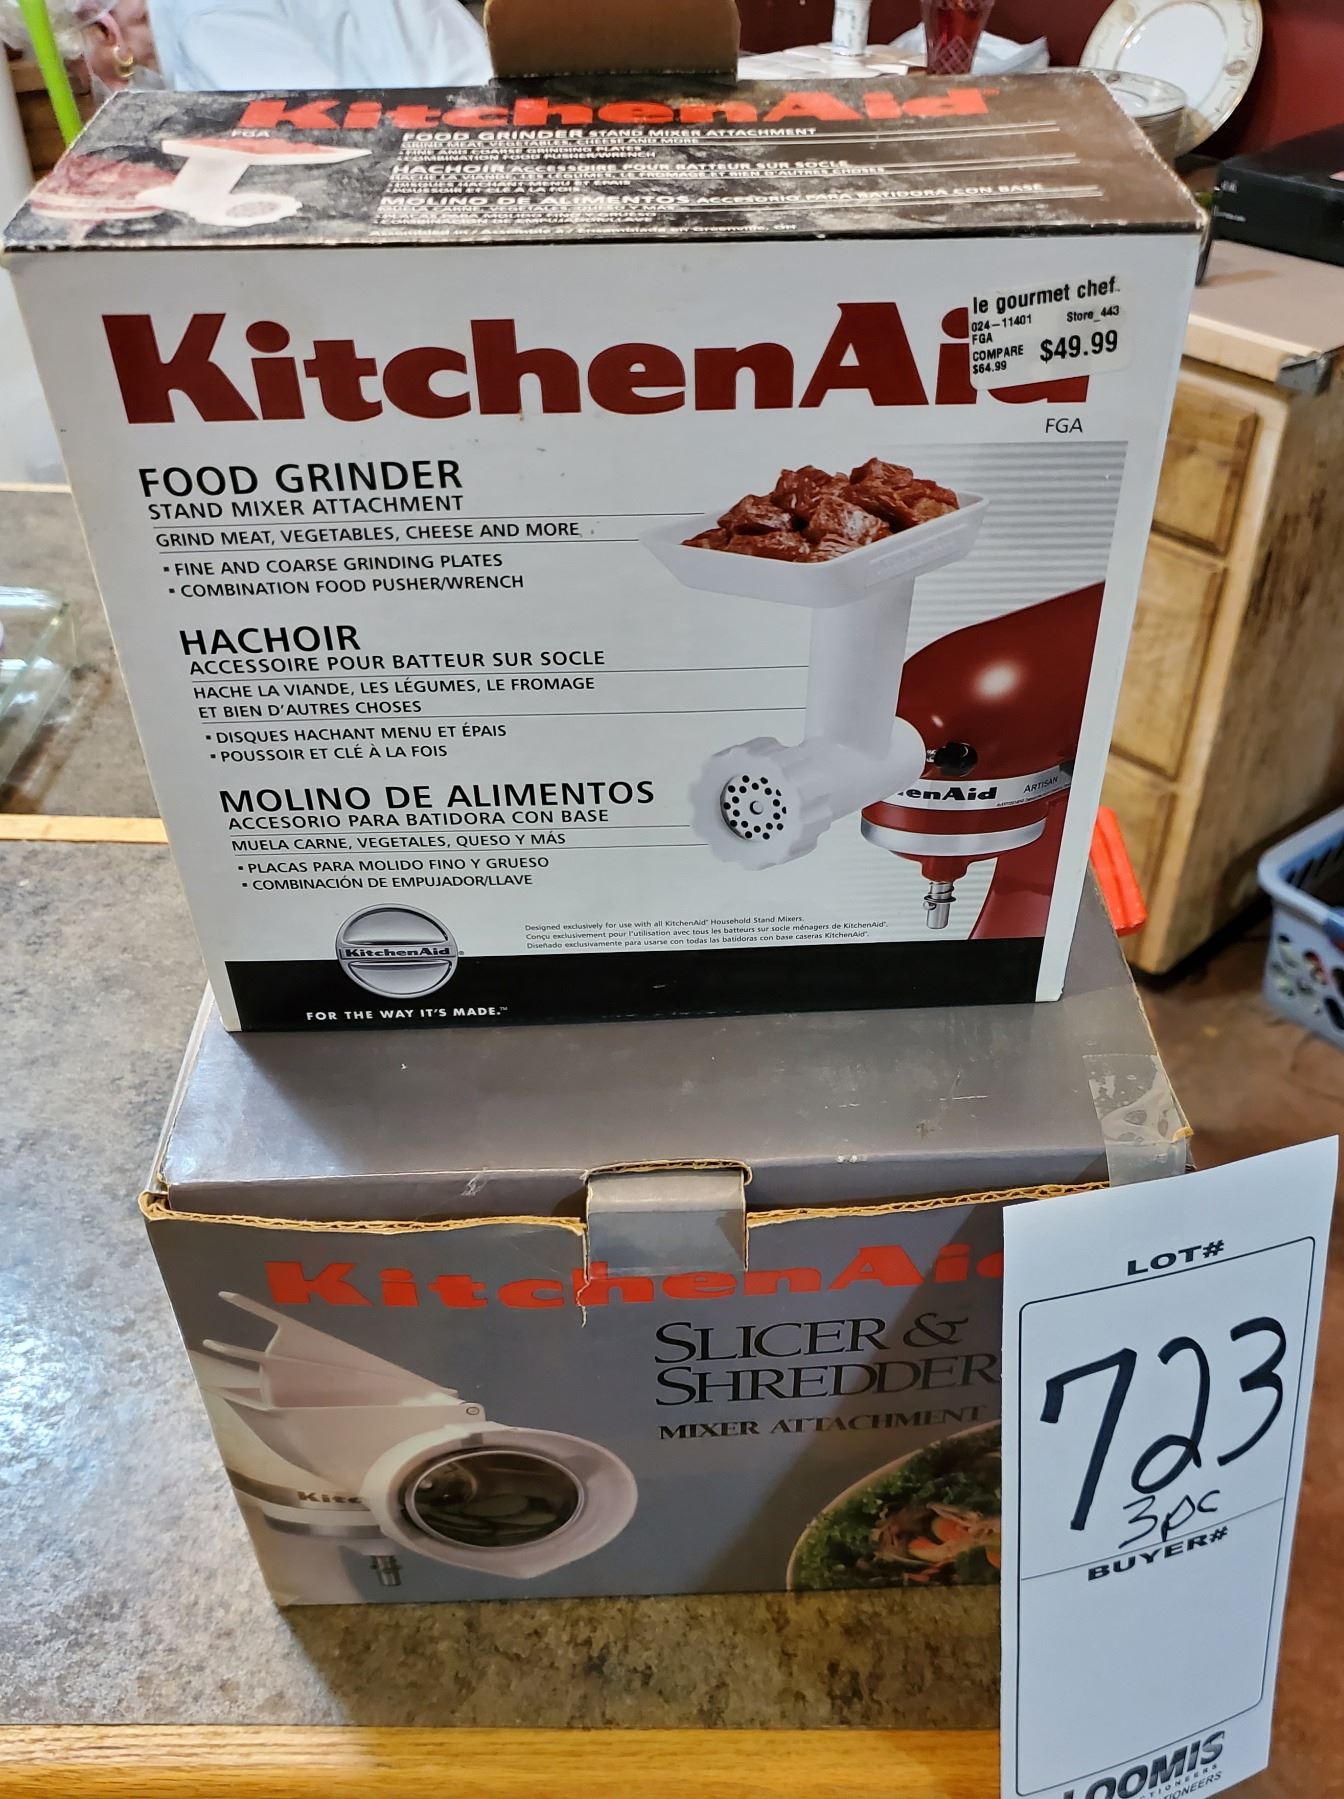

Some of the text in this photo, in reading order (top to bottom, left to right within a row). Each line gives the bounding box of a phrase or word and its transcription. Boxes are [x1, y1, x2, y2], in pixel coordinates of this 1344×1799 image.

[236, 88, 988, 129] KitchenAid
[402, 131, 470, 142] FOOD
[478, 129, 583, 140] GRINDER
[649, 128, 700, 137] MIXER
[706, 128, 816, 136] ATTACHMENT
[973, 296, 988, 314] le
[996, 284, 1070, 313] gourmet
[972, 333, 993, 345] FGA
[1040, 329, 1118, 364] $49.99
[101, 303, 1089, 424] KitchenAi
[972, 344, 1024, 362] COMPARE
[972, 361, 1007, 375] $64.99
[1045, 418, 1083, 433] FGA
[139, 459, 463, 498] FOOD GRINDER
[148, 495, 464, 521] STAND MIXER ATTACHMENT
[156, 521, 579, 548] GRIND MEAT, VEGETABLES, CHEESE AND MORE
[175, 553, 503, 576] FINE AND COARSE GRINDING PLATES
[180, 574, 524, 598] COMBINATION FOOD PUSHER/WRENCH
[179, 624, 361, 656] HACHOIR
[190, 650, 605, 675] ACCESSOIRE POUR BATTEUR SUR SOCLE
[193, 676, 595, 700] HACHE LA VIANDE, LES LÉGUMES, LE FROMAGE
[198, 706, 219, 719] ET
[223, 704, 262, 718] BIEN
[355, 700, 422, 715] CHOSES
[216, 720, 507, 745] DISQUES HACHANT MENU ET ÉPAIS
[220, 742, 448, 763] POUSSOIR ET CLÉ À LA FOIS
[219, 780, 655, 813] MOLINO DE ALIMENTOS
[898, 787, 997, 800] enAid
[228, 808, 609, 831] ACCESORIO PARA BATIDORA CON BASE
[231, 830, 567, 852] MUELA CARNE, VEGETALES, QUESO Y MÁS
[248, 855, 550, 874] PLACAS PARA MOLIDO FINO Y GRUESO
[252, 874, 533, 891] COMBINACIÓN DE EMPUJADOR/LLAVE
[525, 924, 560, 932] Designed
[553, 931, 606, 939] exclusivement
[724, 926, 755, 934] batteurs
[345, 947, 450, 958] KitchenAid
[527, 941, 562, 949] Diseñado
[565, 940, 622, 948] exclusivamente
[710, 936, 720, 944] las
[722, 934, 757, 943] batidoras
[796, 932, 822, 940] caseras
[307, 1011, 337, 1021] FOR
[345, 1010, 374, 1020] THE
[379, 1009, 413, 1019] WAY
[1127, 1240, 1224, 1276] LOT#
[655, 1312, 968, 1363] SLICER &
[656, 1353, 1001, 1406] SHREDDER
[659, 1405, 986, 1440] MIXER ATTACHMENT
[1040, 1316, 1287, 1531] 723
[1088, 1526, 1228, 1582] BUYER#
